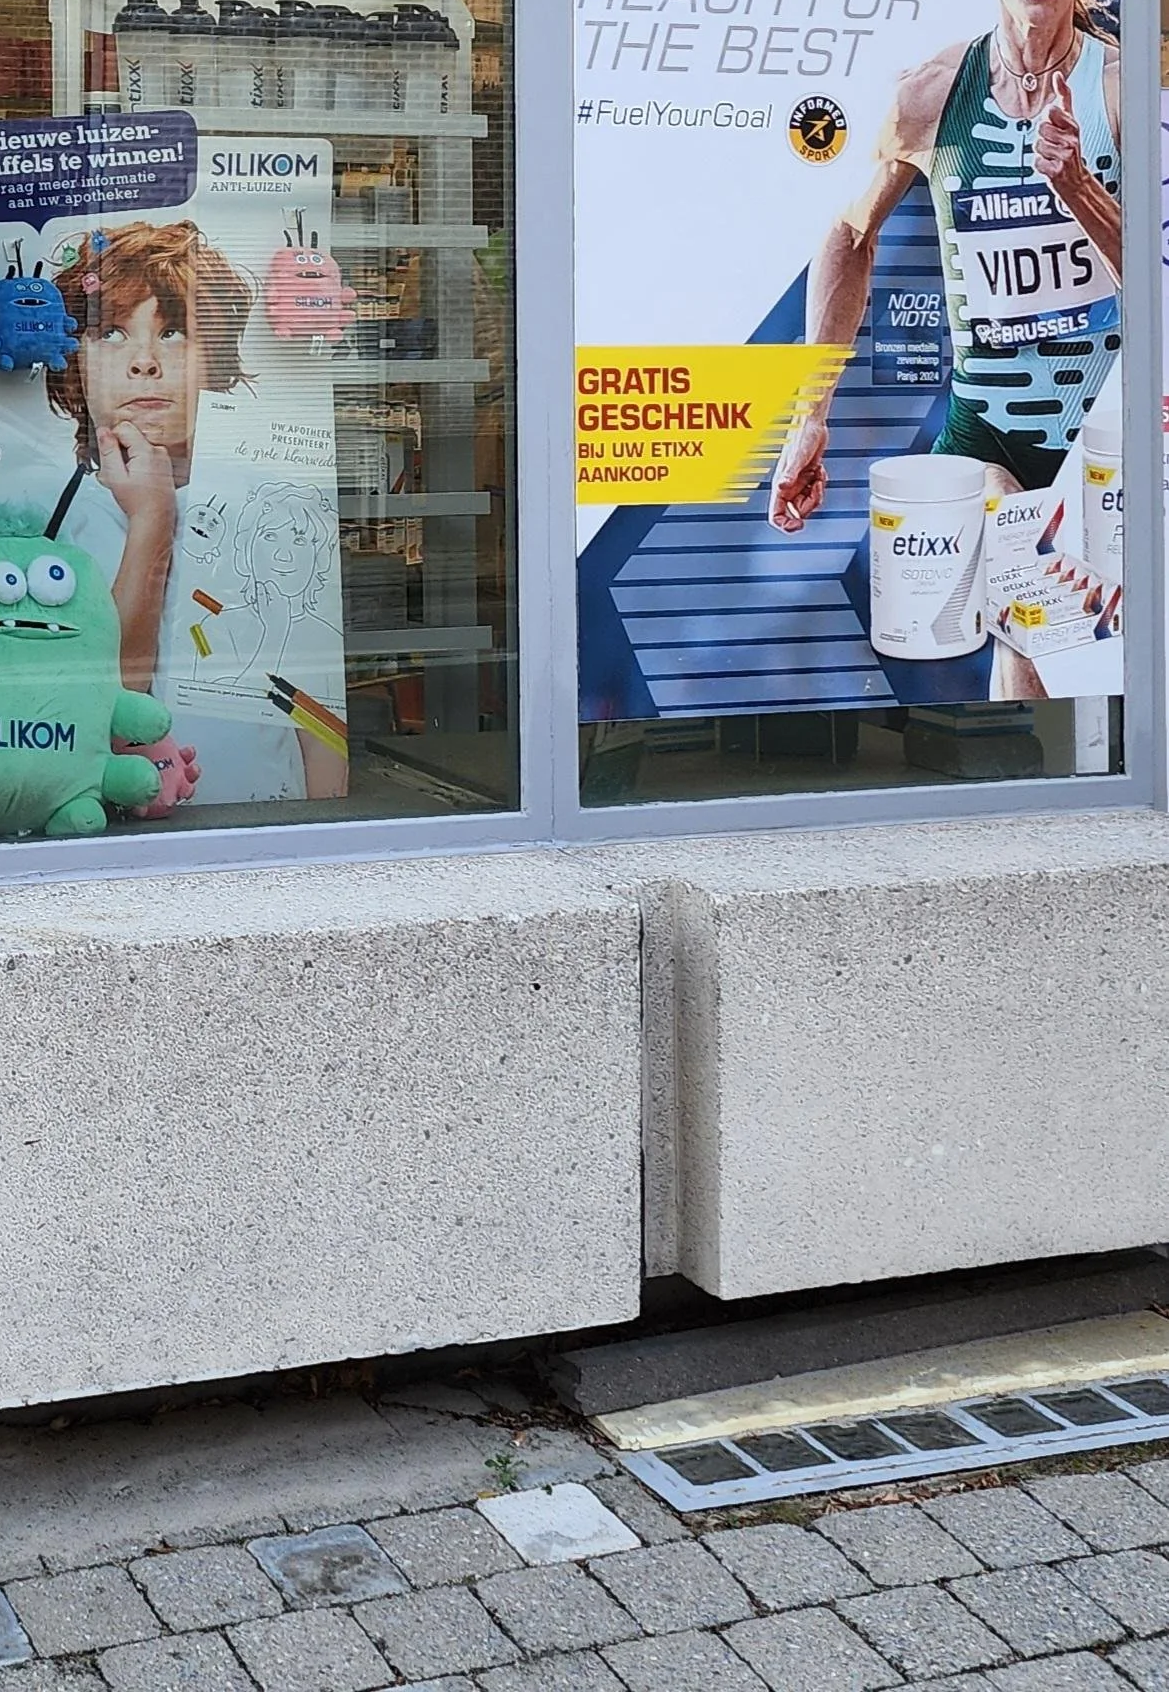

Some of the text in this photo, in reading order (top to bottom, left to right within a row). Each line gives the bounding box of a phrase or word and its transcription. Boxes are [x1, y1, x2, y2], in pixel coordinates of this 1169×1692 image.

[584, 20, 874, 77] THE BEST
[577, 100, 772, 129] #FuelYourGoal
[791, 98, 845, 128] INFORMED
[77, 124, 159, 145] luizen-
[59, 153, 82, 171] te
[87, 142, 184, 169] winnen!
[799, 145, 837, 161] SPORT
[211, 152, 318, 178] SILIKOM
[38, 178, 77, 191] meer
[81, 170, 156, 188] informatie
[210, 181, 292, 194] ANTI-LUIZEN
[8, 187, 141, 209] aan uw apotheker
[970, 193, 1052, 222] Allianz
[977, 238, 1093, 296] VIDTS
[888, 294, 940, 309] NOOR
[891, 311, 941, 327] VIDTS
[1002, 313, 1089, 344] BRUSSELS
[578, 367, 690, 395] GRATIS
[897, 371, 939, 382] Parijs 2024
[578, 403, 752, 431] GESCHENK
[271, 422, 332, 439] UW APOTHEEK
[271, 434, 330, 450] PRESENTEERT
[578, 441, 703, 458] BIJ UW ETIXX
[578, 466, 669, 482] AANKOOP
[879, 516, 895, 527] NEW
[997, 505, 1038, 527] etixx
[893, 532, 955, 557] etixx
